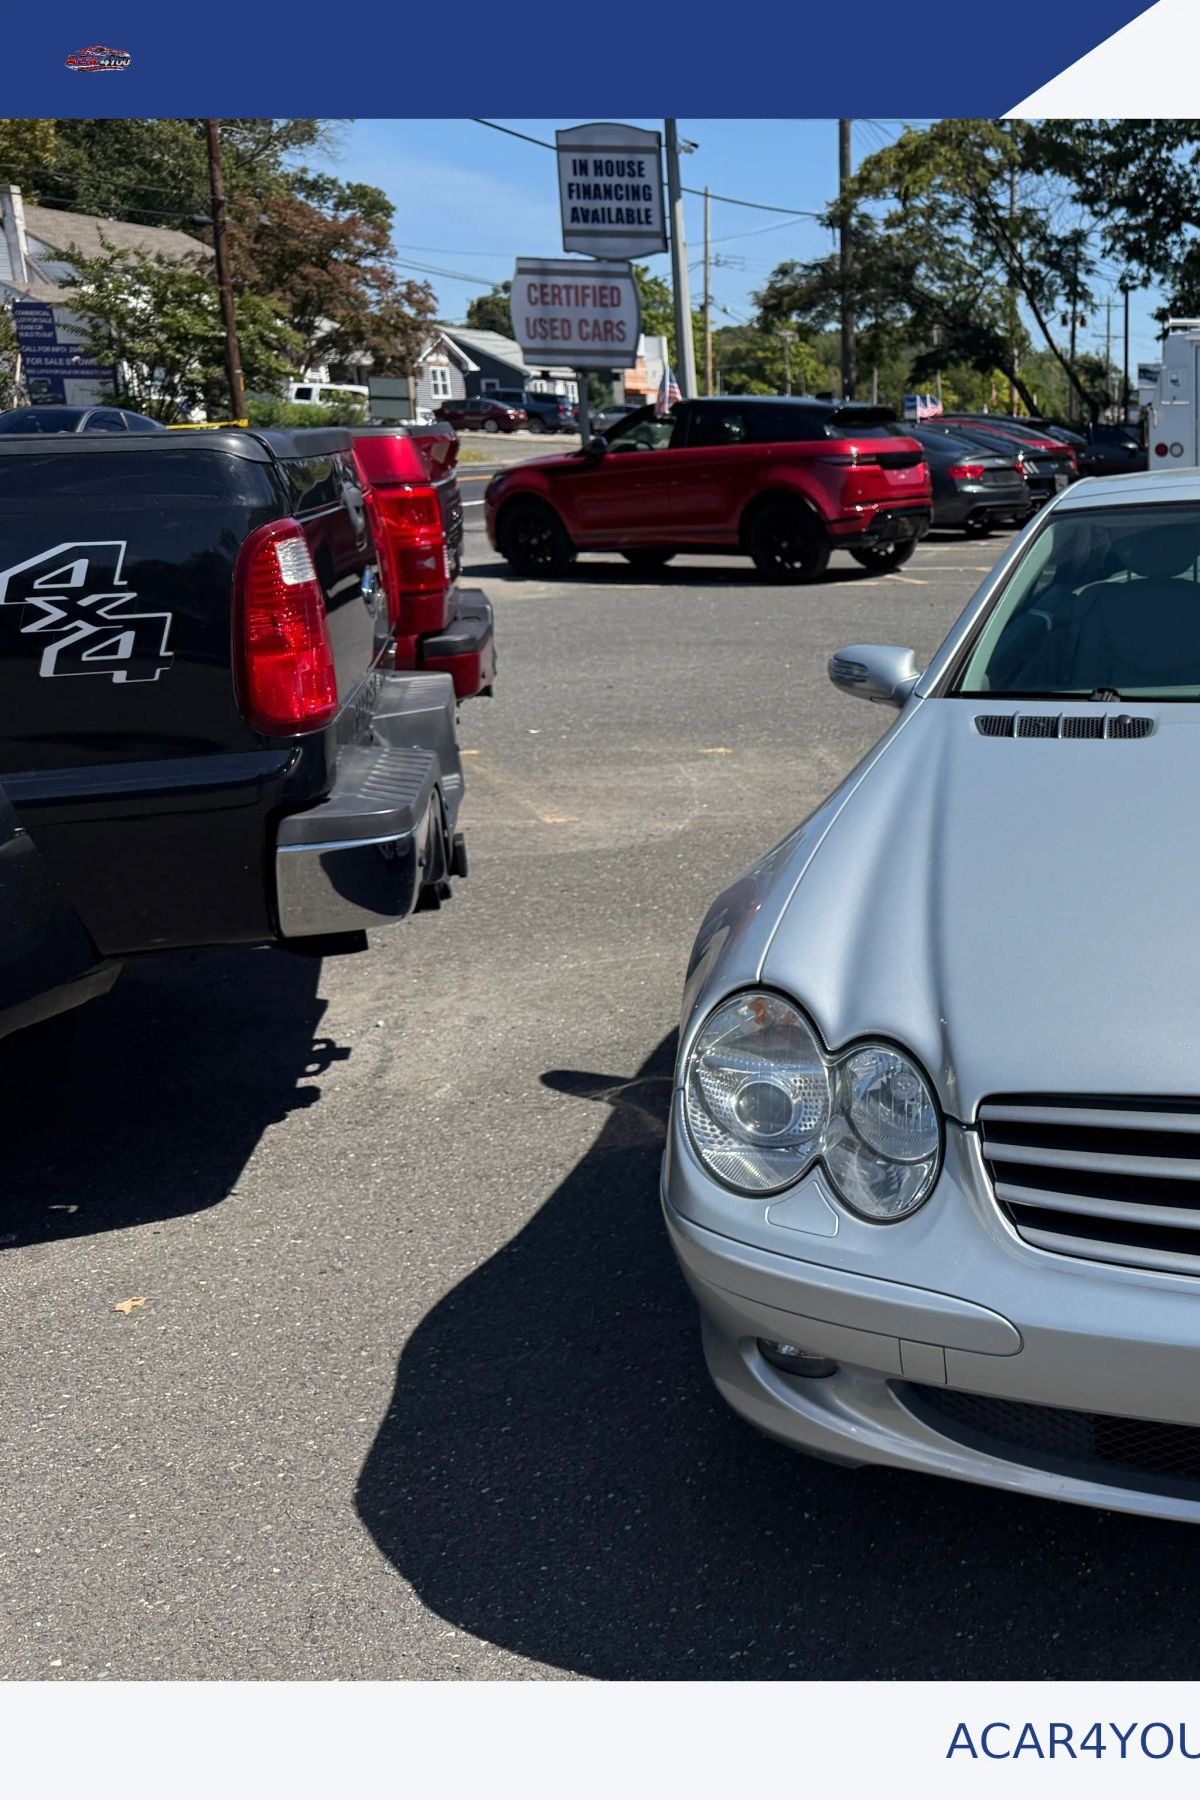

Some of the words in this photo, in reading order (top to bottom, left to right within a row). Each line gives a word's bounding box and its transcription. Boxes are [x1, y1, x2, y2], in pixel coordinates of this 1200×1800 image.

[572, 159, 588, 177] IN
[593, 159, 645, 178] HOUSE
[567, 183, 653, 202] FINANCING
[570, 206, 653, 225] AVAILABLE
[527, 283, 622, 308] CERTIFIED
[525, 317, 572, 341] USED
[578, 318, 627, 343] CARS
